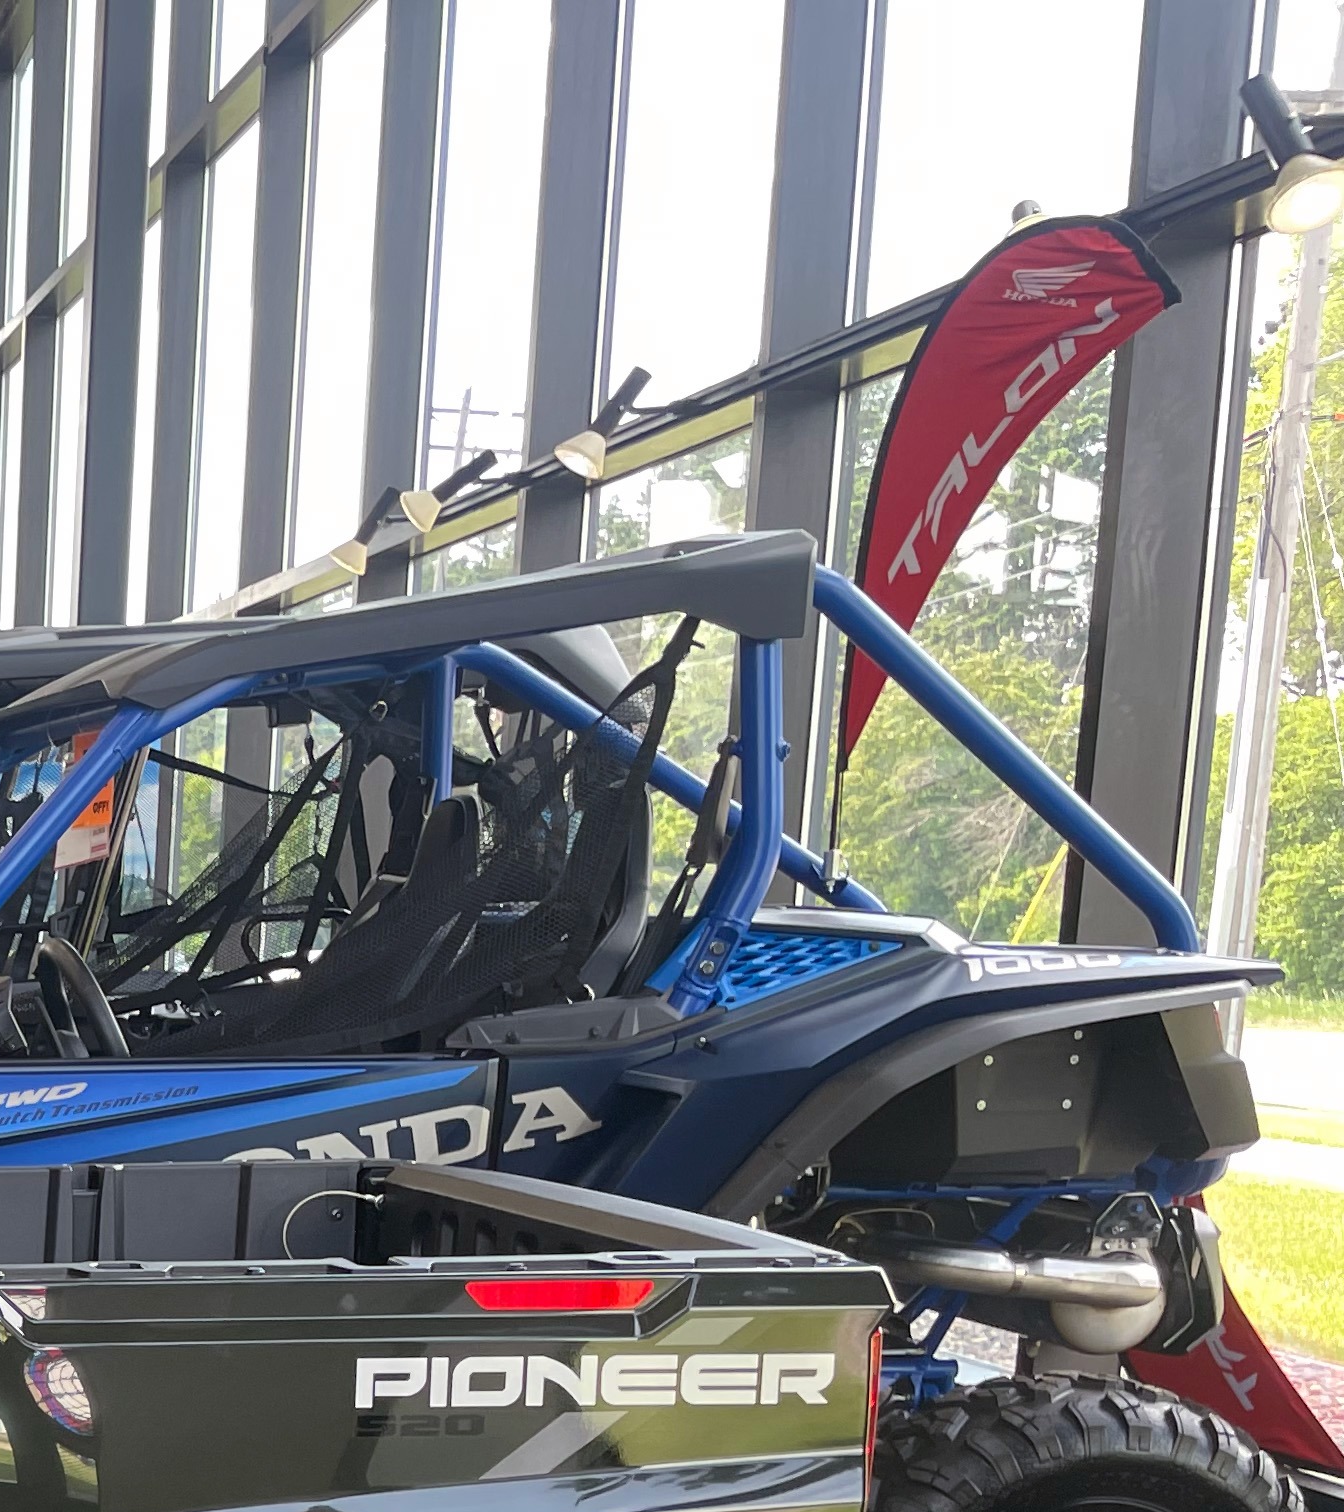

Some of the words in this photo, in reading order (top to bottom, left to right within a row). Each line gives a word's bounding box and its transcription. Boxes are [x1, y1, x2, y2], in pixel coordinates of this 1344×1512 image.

[1002, 289, 1078, 308] HODA
[888, 297, 1120, 584] TALON
[49, 1085, 199, 1118] Transmission
[355, 1353, 835, 1409] PIONEER
[356, 1415, 485, 1437] 520
